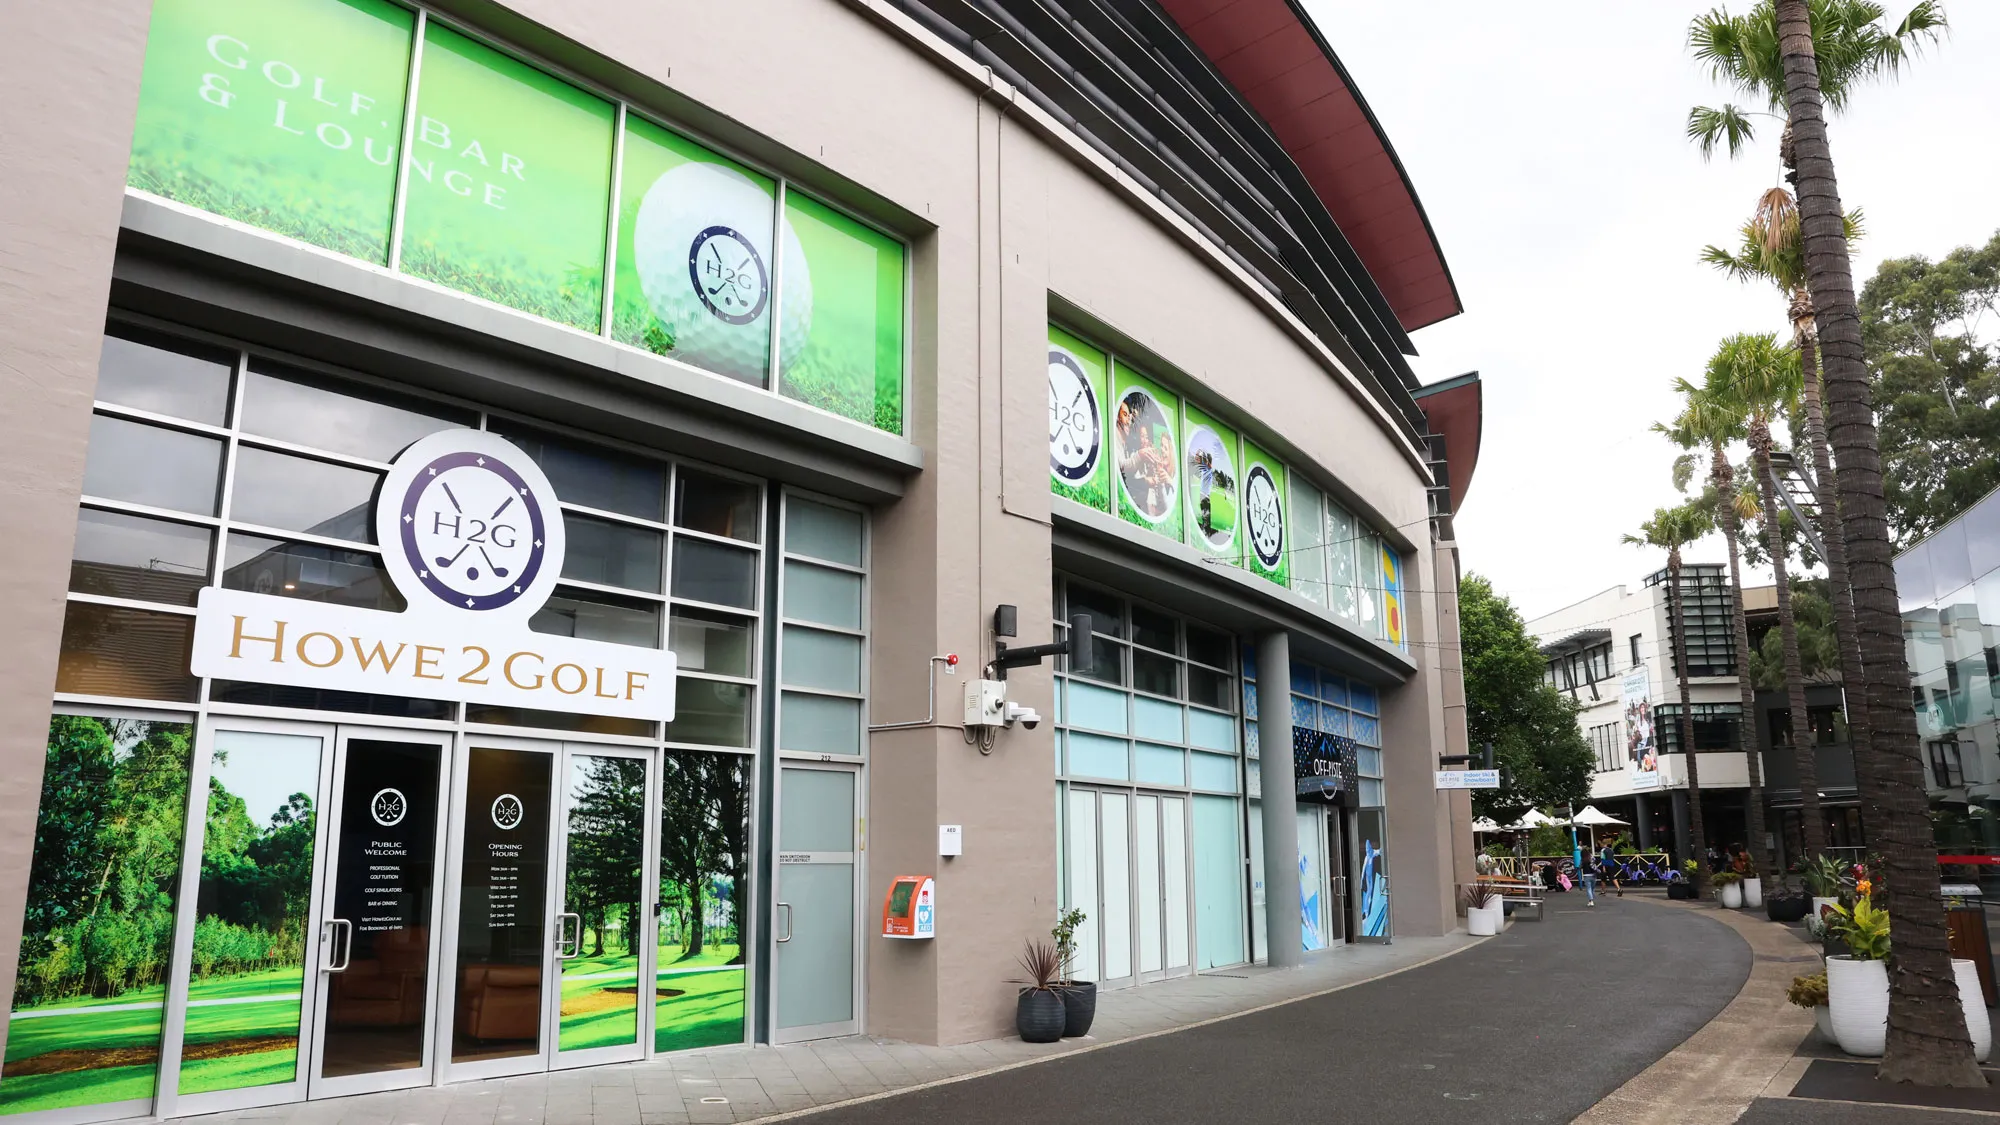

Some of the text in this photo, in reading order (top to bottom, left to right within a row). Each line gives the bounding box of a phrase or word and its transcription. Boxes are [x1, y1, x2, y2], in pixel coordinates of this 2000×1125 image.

[199, 72, 508, 210] & LOUNGE
[418, 115, 526, 182] BAR
[704, 259, 752, 290] H2G
[1253, 503, 1276, 528] H2G
[432, 510, 518, 549] H2G
[227, 614, 650, 701] HOWE2GOLF
[821, 754, 831, 762] 212
[1313, 758, 1343, 779] OFF-PISTE
[378, 803, 400, 811] H2G
[497, 808, 517, 816] H2G
[364, 848, 407, 856] WELCOME
[371, 840, 402, 848] PUBLIC
